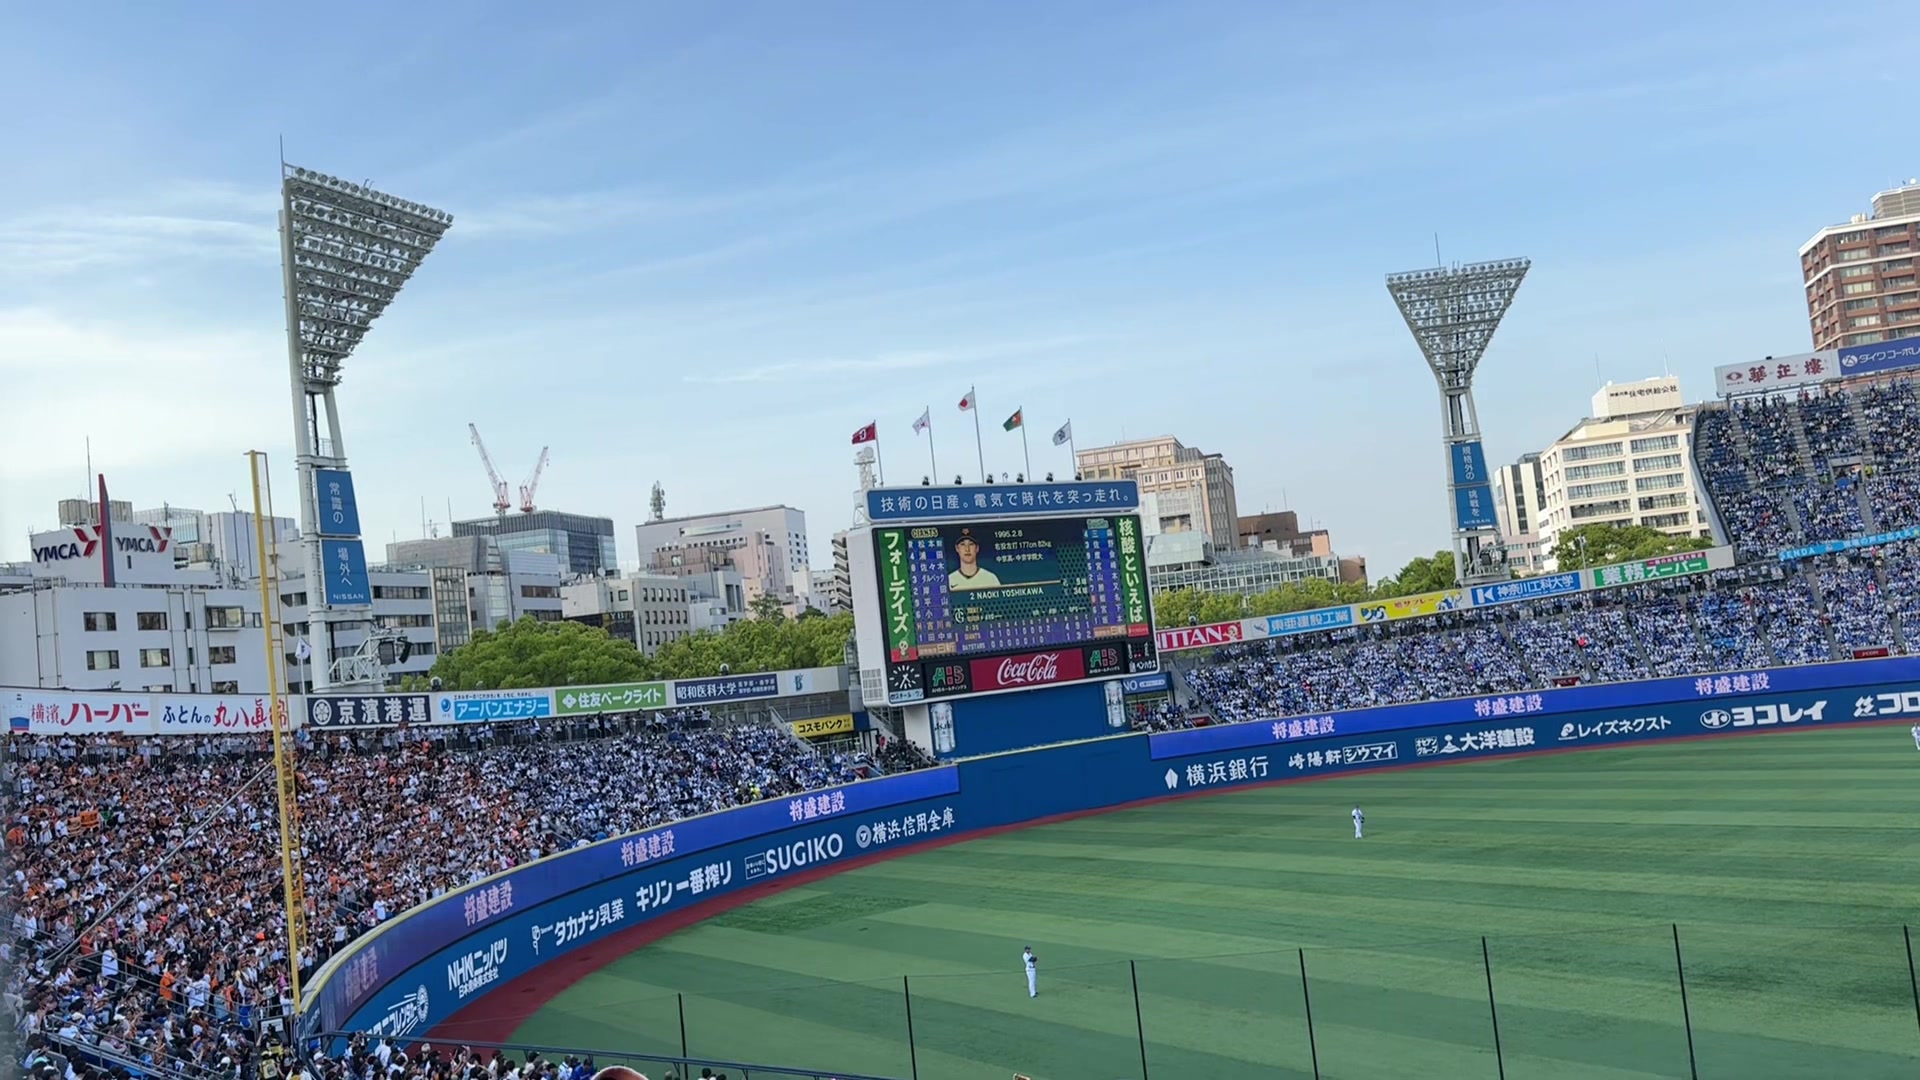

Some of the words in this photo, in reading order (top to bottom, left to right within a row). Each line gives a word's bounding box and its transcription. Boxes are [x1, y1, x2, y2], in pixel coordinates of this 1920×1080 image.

[32, 543, 80, 563] YMCA
[116, 537, 155, 552] YMCA
[338, 547, 352, 586] 場外へ
[1119, 518, 1143, 623] 核酸といえば
[1601, 560, 1702, 585] 業務スーパー
[884, 532, 908, 634] フォーデイズ
[977, 590, 999, 600] NAOKI
[1002, 587, 1044, 597] YOSHIKAWA
[1497, 575, 1574, 597] 神奈川工科大学
[1271, 608, 1349, 632] 東亜建設工業
[676, 683, 736, 700] 昭和医科大学
[1695, 672, 1770, 694] 将盛建設
[457, 699, 548, 718] アーバンエナジー
[578, 688, 662, 708] 住友ベークライト
[1474, 694, 1543, 716] 将盛建設
[337, 698, 427, 725] 京濱港運
[1732, 701, 1827, 727] ヨコレイ
[799, 719, 842, 732] コスモバンク
[1272, 717, 1335, 739] 将盛建設
[1578, 716, 1671, 737] レイズネクスト
[1460, 727, 1535, 751] 大洋建設
[1288, 750, 1342, 770] 崎陽軒
[1345, 744, 1394, 762] シウマイ
[1186, 756, 1269, 786] 横浜銀行
[789, 791, 846, 822] 将盛建設
[872, 807, 955, 845] 横浜信用金庫
[621, 831, 675, 866] 将盛建設
[766, 833, 843, 874] SUGIKO
[635, 860, 731, 913] キリン一番搾り
[463, 880, 513, 927] 将盛建設
[554, 898, 625, 946] タカナシ乳業
[448, 937, 507, 991] NHKニッパツ
